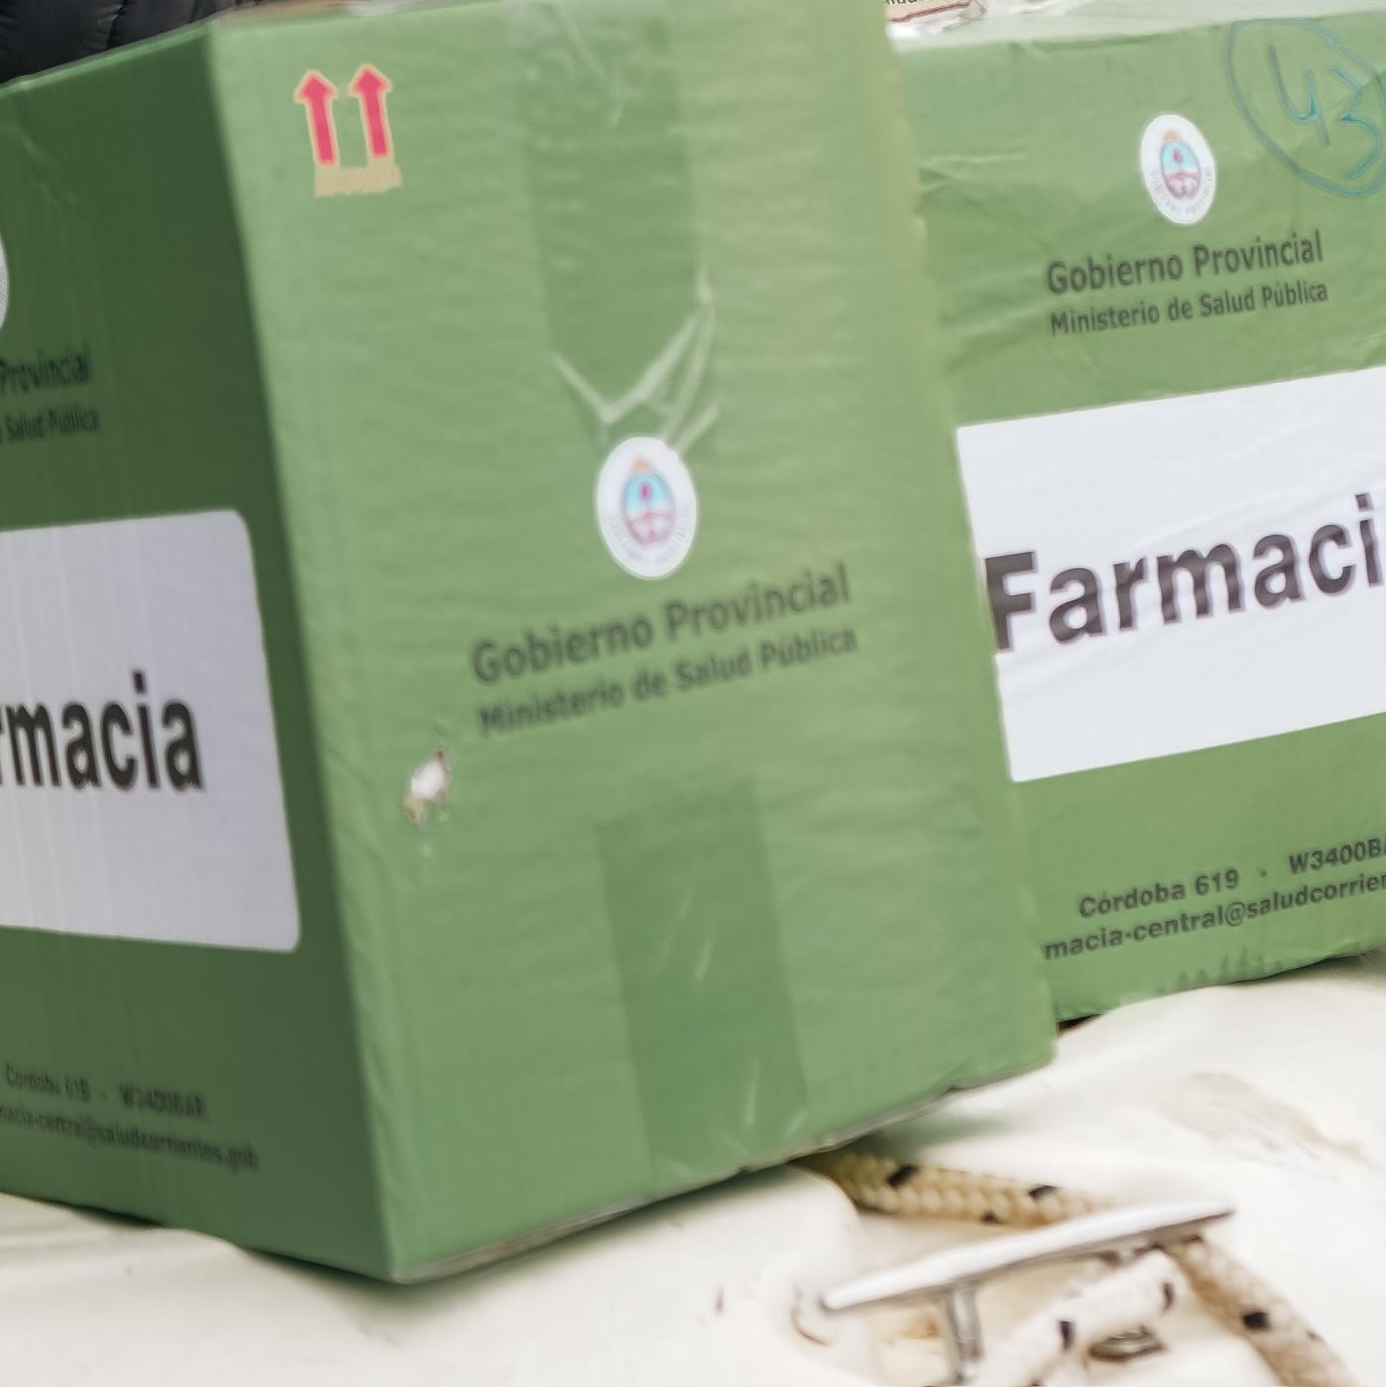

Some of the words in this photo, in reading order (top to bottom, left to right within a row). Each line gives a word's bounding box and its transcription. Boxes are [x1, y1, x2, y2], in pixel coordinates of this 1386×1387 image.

[1047, 253, 1183, 294] Gobierno
[1192, 229, 1323, 277] Provincial
[1050, 301, 1160, 335] Ministerio
[1167, 296, 1193, 322] de
[1200, 286, 1255, 317] Salud
[1262, 279, 1328, 310] Pública
[471, 616, 653, 685] Gobierno
[666, 562, 852, 641] Provincial
[478, 677, 624, 737] Ministerio
[633, 668, 668, 702] de
[675, 647, 752, 692] Salud
[760, 626, 858, 669] Pública
[1195, 868, 1239, 896] 619
